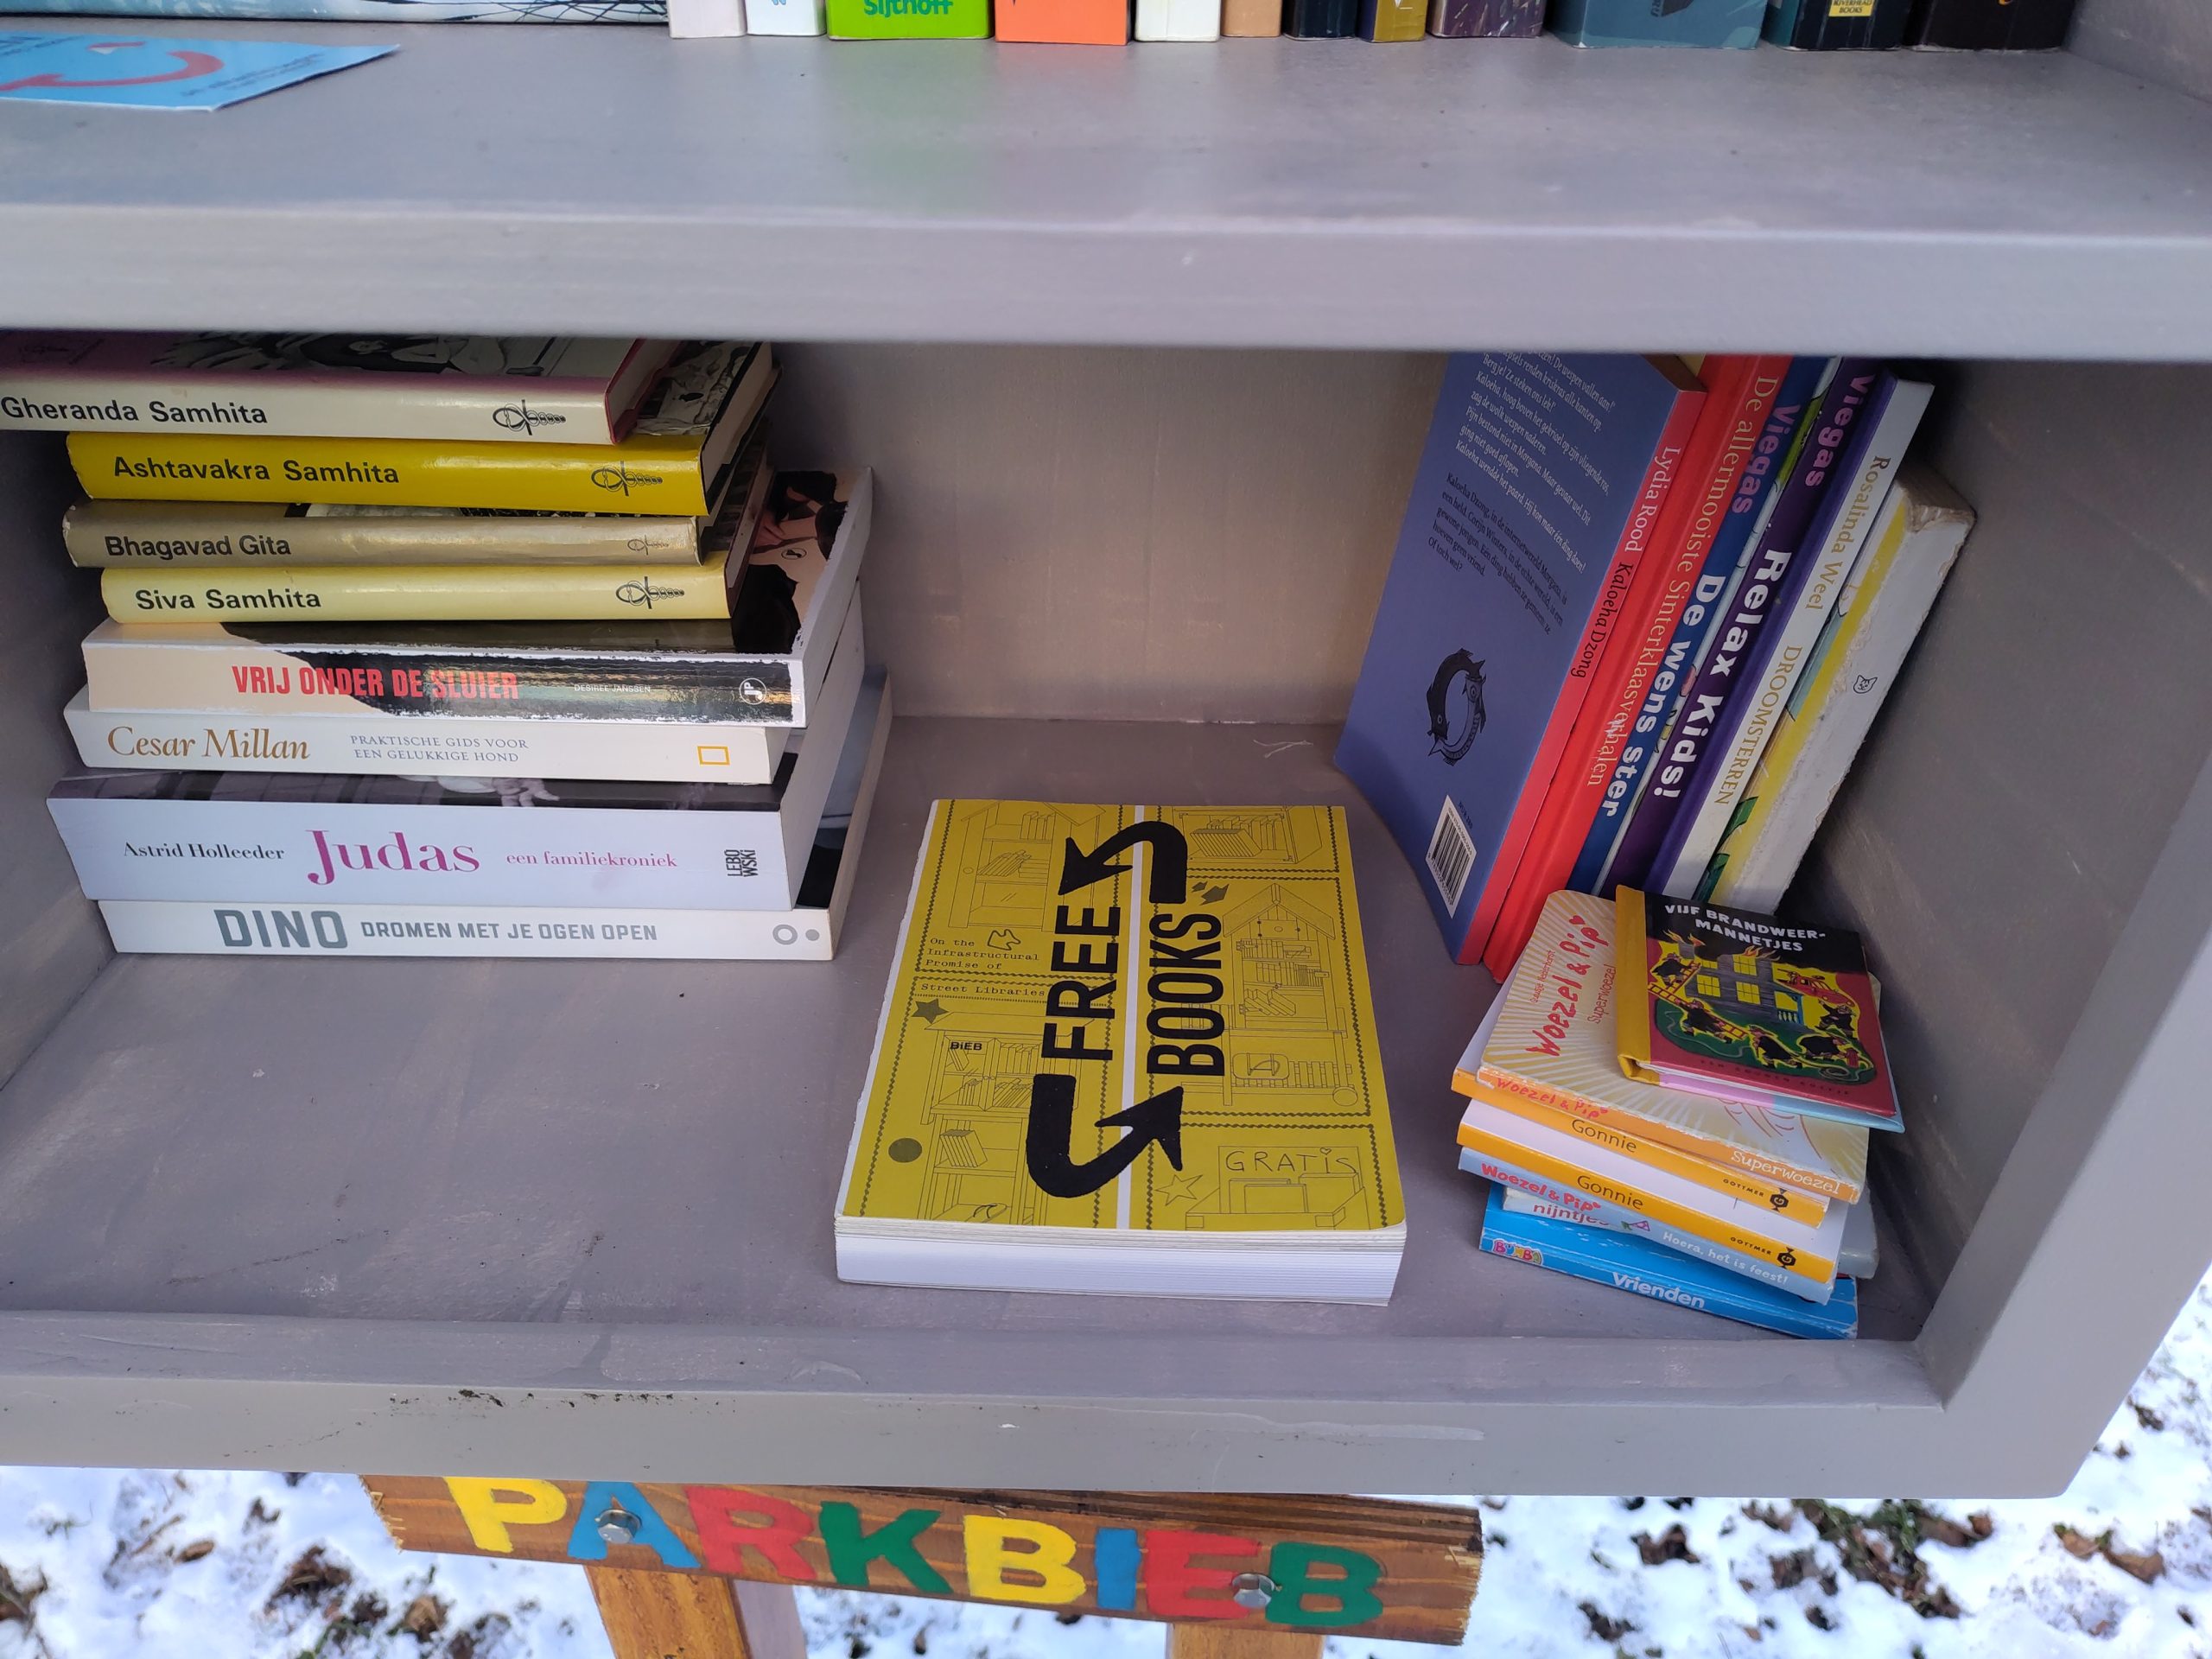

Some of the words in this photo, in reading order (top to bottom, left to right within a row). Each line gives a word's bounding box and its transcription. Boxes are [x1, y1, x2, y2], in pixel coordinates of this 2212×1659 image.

[864, 0, 953, 17] Sijthoff
[1, 397, 139, 421] Gheranda
[151, 400, 268, 424] Samhita
[1502, 387, 1516, 409] hoog
[1516, 397, 1533, 419] boven
[1532, 410, 1542, 427] het
[1745, 376, 1779, 412] De
[1459, 424, 1474, 442] ging
[1473, 435, 1485, 448] niet
[1484, 444, 1500, 458] goed
[1471, 391, 1482, 405] zag
[1481, 395, 1490, 408] de
[1489, 404, 1503, 419] wolk
[1503, 414, 1524, 435] wespen
[1524, 431, 1545, 454] naderen.
[1805, 374, 1876, 486] Viegas
[114, 456, 270, 481] Ashtavakra
[285, 460, 399, 485] Samhita
[1478, 413, 1501, 437] bestond
[1499, 433, 1511, 447] niet
[1510, 442, 1517, 453] in
[1541, 467, 1556, 486] Maar
[1581, 509, 1590, 525] Dit
[1645, 447, 1681, 499] Lydia
[1732, 404, 1801, 514] Viegas
[1455, 439, 1478, 463] Kaloeha
[1478, 460, 1499, 480] wendde
[1498, 473, 1508, 489] het
[1532, 505, 1541, 522] kon
[1677, 421, 1755, 572] allermooiste
[1831, 455, 1891, 554] Rosalinda
[105, 535, 232, 560] Bhagavad
[239, 534, 291, 556] Gita
[1624, 504, 1658, 552] Rood
[136, 589, 194, 610] Siva
[207, 588, 321, 609] Samhita
[1598, 562, 1633, 628] Kaloeha
[1682, 574, 1726, 626] De
[1805, 560, 1844, 611] Weel
[1709, 550, 1792, 677] Relax
[1571, 630, 1606, 679] Dzong
[231, 665, 292, 696] VRIJ
[300, 666, 384, 697] ONDER
[393, 670, 423, 698] DE
[431, 671, 519, 702] SLUIER
[1587, 579, 1691, 786] Sinterklaasverhalen
[1636, 639, 1692, 734] wens
[107, 726, 196, 758] Cesar
[202, 728, 311, 760] Millan
[350, 734, 440, 747] PRAKTISCHE
[446, 736, 480, 748] GIDS
[485, 738, 529, 749] VOOR
[1714, 645, 1803, 805] DROOMSTERREN
[354, 748, 382, 760] EEN
[387, 749, 471, 761] GELUKKIGE
[474, 751, 519, 762] HOND
[1654, 694, 1724, 799] Kids!
[1602, 746, 1643, 817] ster
[124, 842, 183, 858] Astrid
[188, 843, 284, 861] Holleeder
[305, 830, 480, 886] Judas
[506, 854, 537, 865] een
[543, 850, 677, 868] familiekroniek
[213, 909, 348, 949] DINO
[361, 921, 452, 939] DROMEN
[458, 923, 499, 939] MET
[507, 923, 534, 940] JE
[540, 924, 595, 941] OGEN
[602, 925, 658, 942] OPEN
[1559, 927, 1609, 957] Pip
[1665, 905, 1700, 916] VIJF
[1706, 909, 1826, 939] BRANDWEER-
[1694, 918, 1803, 951] MANNETJES
[925, 959, 979, 969] Promise
[927, 948, 1040, 961] Infrastructural
[1567, 963, 1592, 976] &
[921, 983, 968, 993] Street
[976, 986, 1046, 997] Libraries
[1041, 904, 1122, 1061] FREE
[1147, 912, 1225, 1076] BOOKS
[1496, 1077, 1556, 1104] Woezel
[1560, 1100, 1569, 1111] &
[1574, 1101, 1602, 1120] Pip
[1572, 1118, 1637, 1154] Gonnie
[1481, 1163, 1548, 1196] Woezel
[1548, 1189, 1560, 1202] &
[1563, 1192, 1594, 1211] Pip
[1722, 1179, 1764, 1198] GOTTMER
[1731, 1150, 1840, 1194] Superwoezel
[1577, 1175, 1643, 1210] Gonnie
[1534, 1203, 1609, 1225] nijntje
[1662, 1231, 1705, 1255] Hoera,
[1708, 1249, 1731, 1265] het
[1733, 1259, 1746, 1270] is
[1750, 1264, 1789, 1285] feest!
[1730, 1236, 1771, 1255] GOTTMER
[1612, 1271, 1705, 1310] Vrienden
